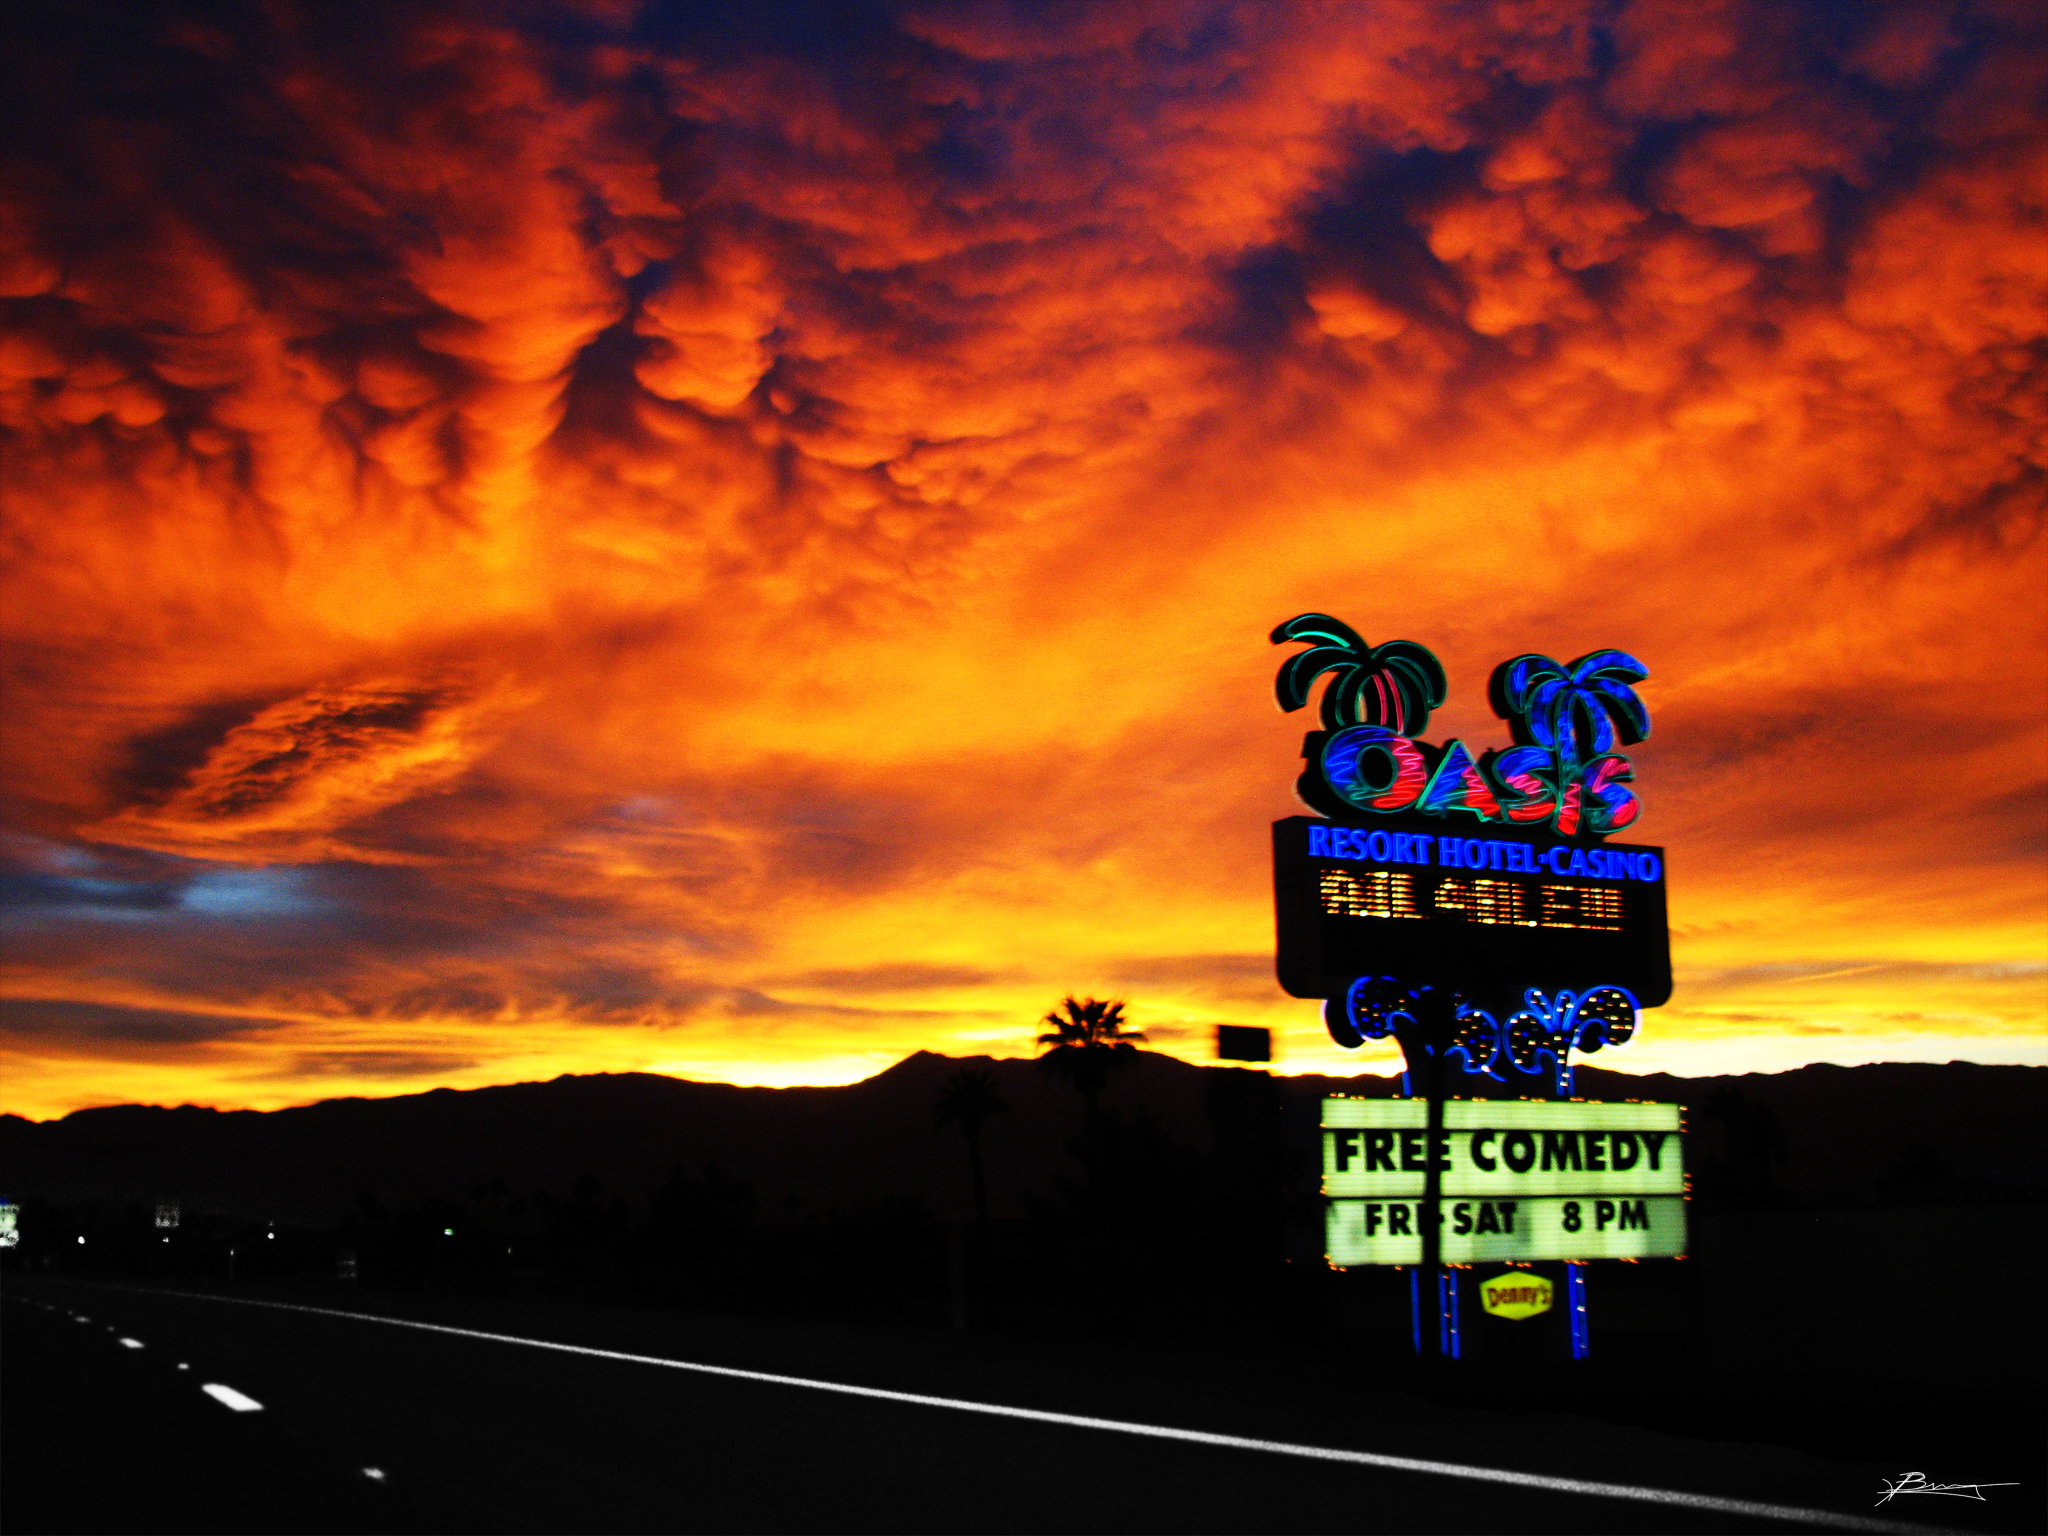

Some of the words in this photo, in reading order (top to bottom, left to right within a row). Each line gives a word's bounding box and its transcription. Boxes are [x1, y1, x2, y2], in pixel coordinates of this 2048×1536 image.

[1322, 723, 1641, 836] OASIS
[1307, 824, 1434, 866] RESORT
[1335, 1130, 1452, 1172] FREE
[1470, 1129, 1667, 1173] COMEDY
[1562, 1201, 1583, 1233] 8
[1596, 1201, 1650, 1232] PM
